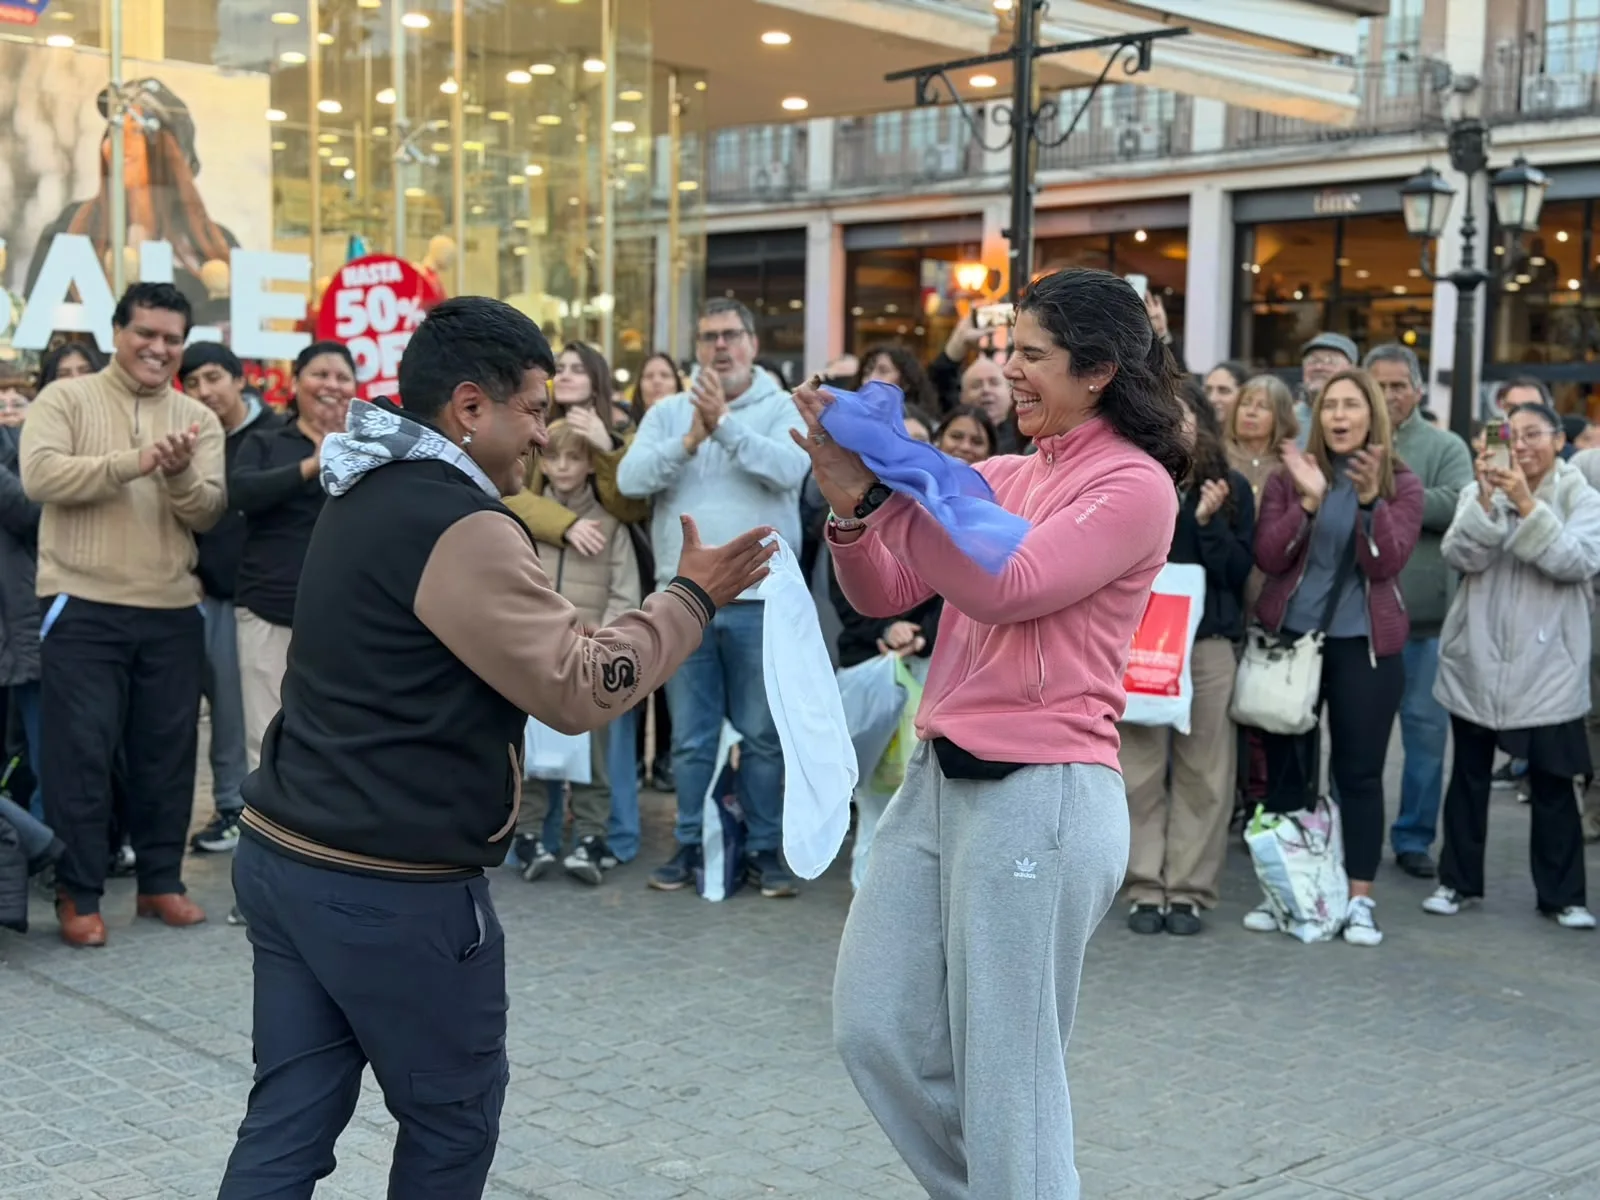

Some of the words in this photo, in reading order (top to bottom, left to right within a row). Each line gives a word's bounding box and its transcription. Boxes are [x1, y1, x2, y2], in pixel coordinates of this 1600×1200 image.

[341, 260, 404, 288] HASTA
[335, 284, 427, 338] 50%
[346, 332, 413, 382] OF
[1013, 871, 1036, 879] adidas
